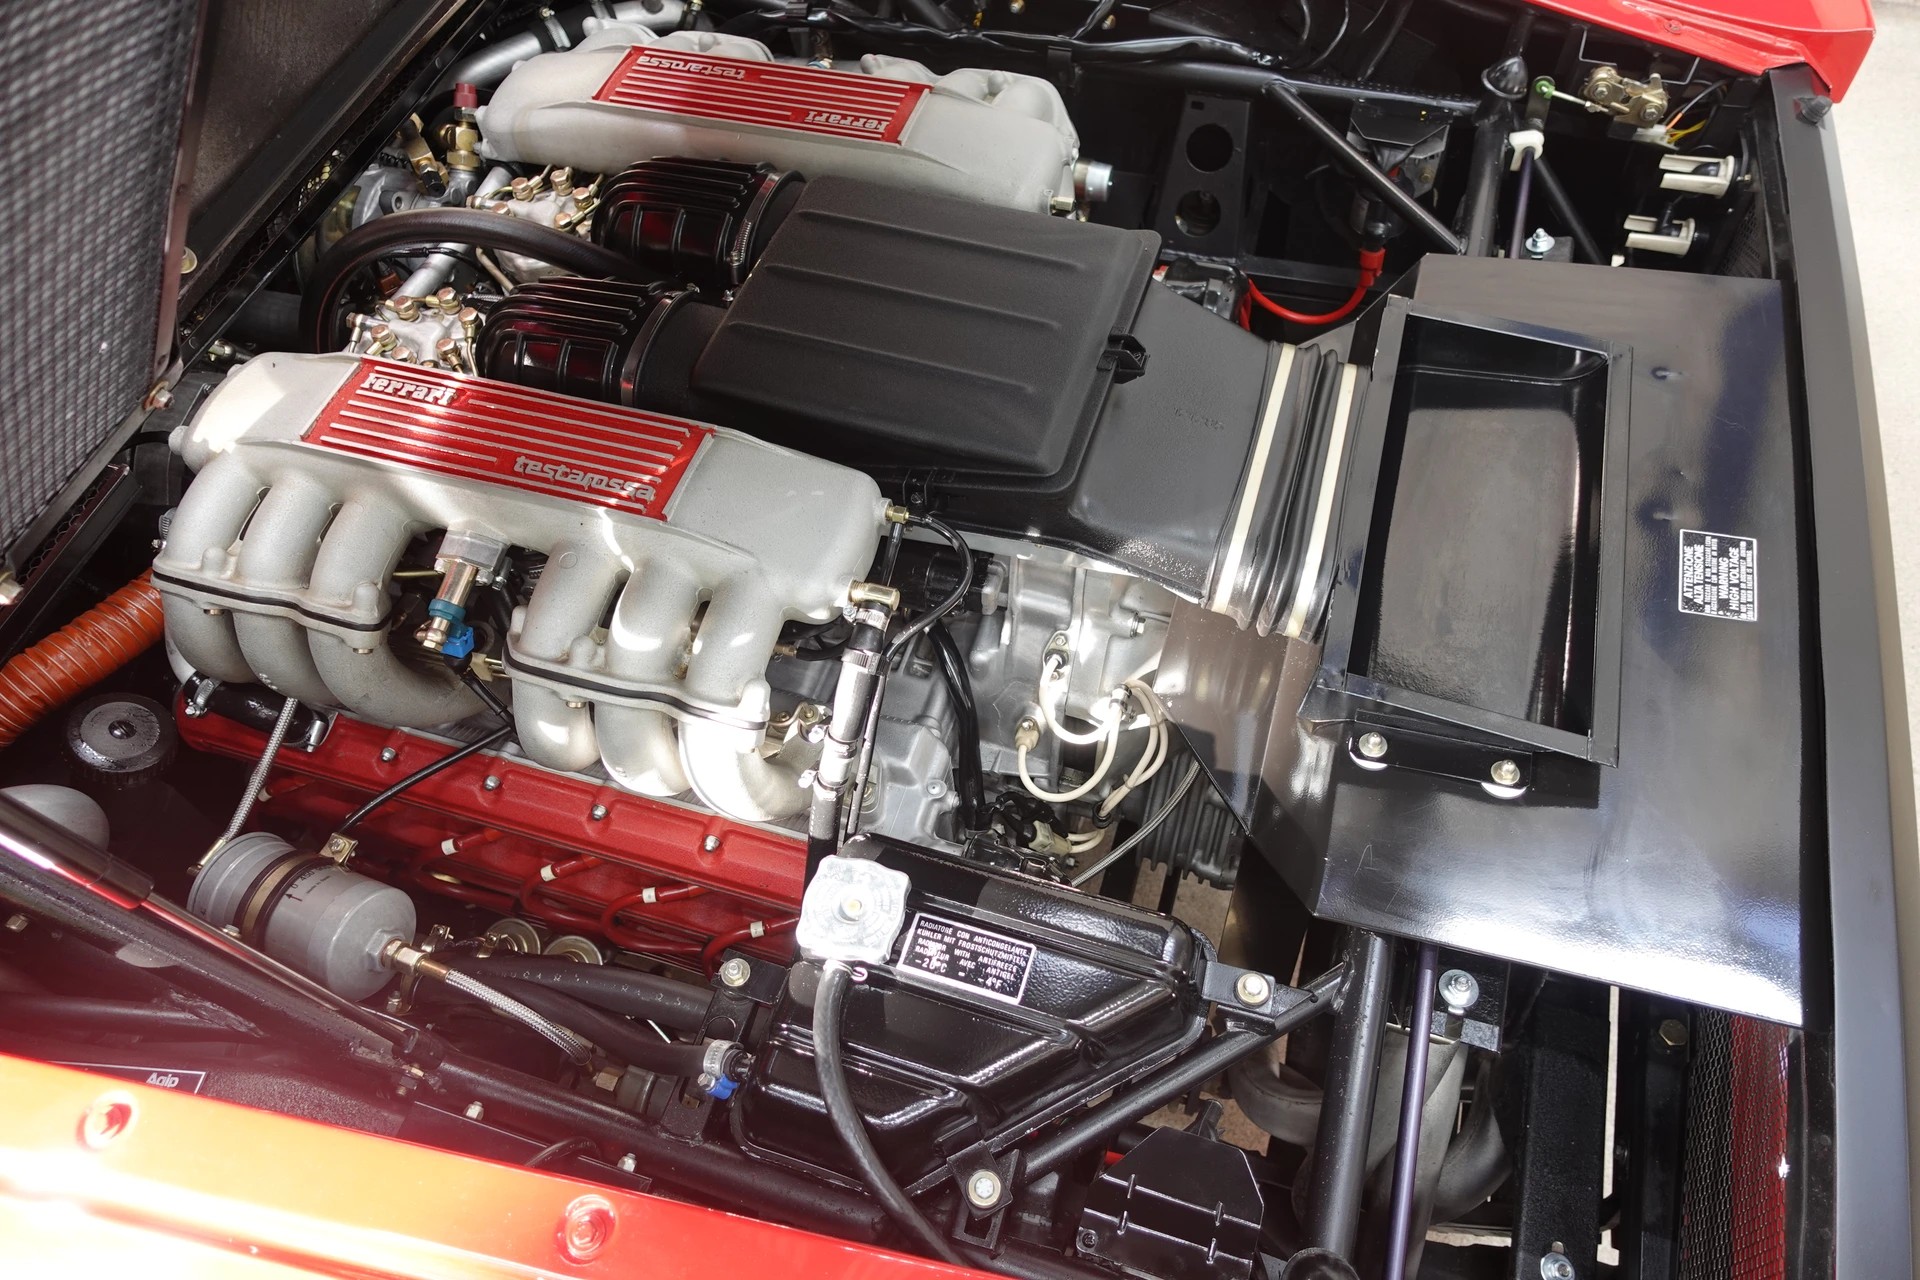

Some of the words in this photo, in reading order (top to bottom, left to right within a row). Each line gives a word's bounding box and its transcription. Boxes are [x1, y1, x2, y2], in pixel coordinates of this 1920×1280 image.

[360, 372, 457, 406] Ferrari
[513, 455, 657, 503] testarossa
[1684, 545, 1693, 599] ATTENZIONE
[1694, 544, 1704, 584] TENSIONE
[1719, 557, 1729, 599] WARNING
[1729, 546, 1740, 584] VOLTAGE
[1694, 584, 1704, 605] ALTA
[1729, 586, 1740, 611] HIGH
[919, 920, 954, 935] RADIATORE
[956, 930, 970, 940] CON
[943, 935, 956, 945] MIT
[915, 945, 950, 961] RADEUR
[959, 959, 977, 969] AVEC
[917, 937, 947, 952] RADOR
[954, 948, 971, 958] WITH
[977, 955, 1018, 973] ANTIFREEZE
